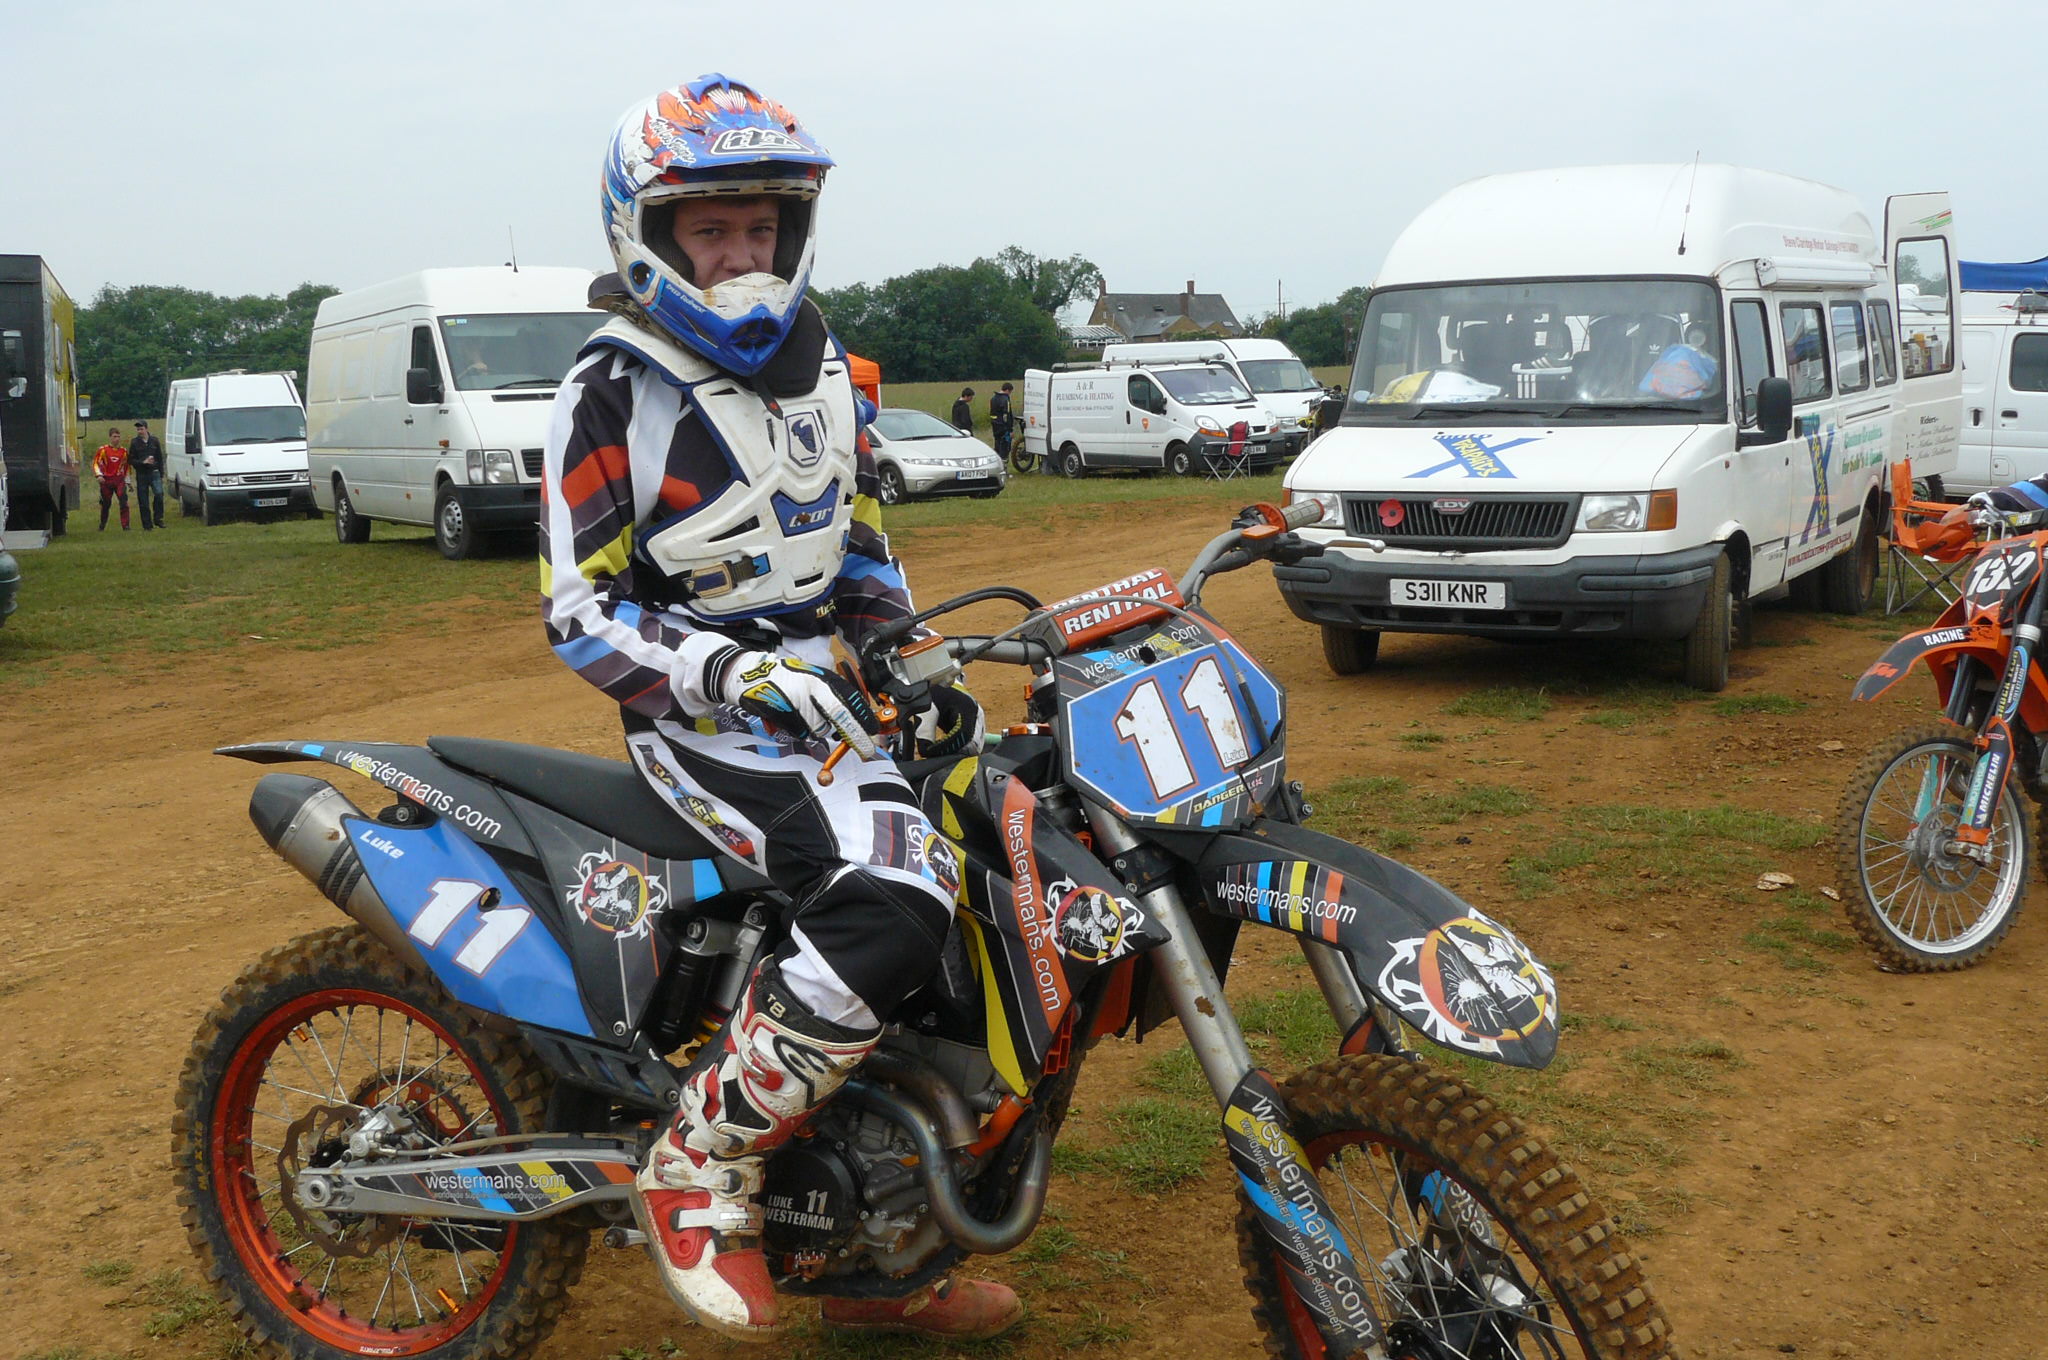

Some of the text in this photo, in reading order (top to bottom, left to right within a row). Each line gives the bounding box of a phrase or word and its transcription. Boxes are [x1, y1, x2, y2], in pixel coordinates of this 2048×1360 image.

[1056, 393, 1083, 401] PLUMBING
[1089, 392, 1114, 401] HEATING
[1967, 551, 2036, 596] 132
[1405, 583, 1488, 604] S311 KNR
[1923, 628, 1966, 646] RACING
[1113, 654, 1251, 802] 11
[1224, 748, 1247, 764] Luke
[342, 749, 502, 839] westermans.com
[1978, 752, 2001, 812] MICHELIN
[1193, 783, 1246, 813] DANGER
[359, 829, 405, 860] Luke
[1004, 808, 1062, 1013] westermans.com
[1217, 880, 1357, 925] westermans.com
[406, 877, 534, 979] 11
[425, 1173, 567, 1190] westermans.com
[768, 1194, 793, 1210] LUKE
[807, 1189, 828, 1215] 11
[763, 1206, 835, 1231] WESTERMAN
[1252, 1096, 1375, 1341] westermans.com
[1285, 1220, 1300, 1238] of
[1291, 1231, 1318, 1279] welding
[1311, 1275, 1347, 1337] equipment
